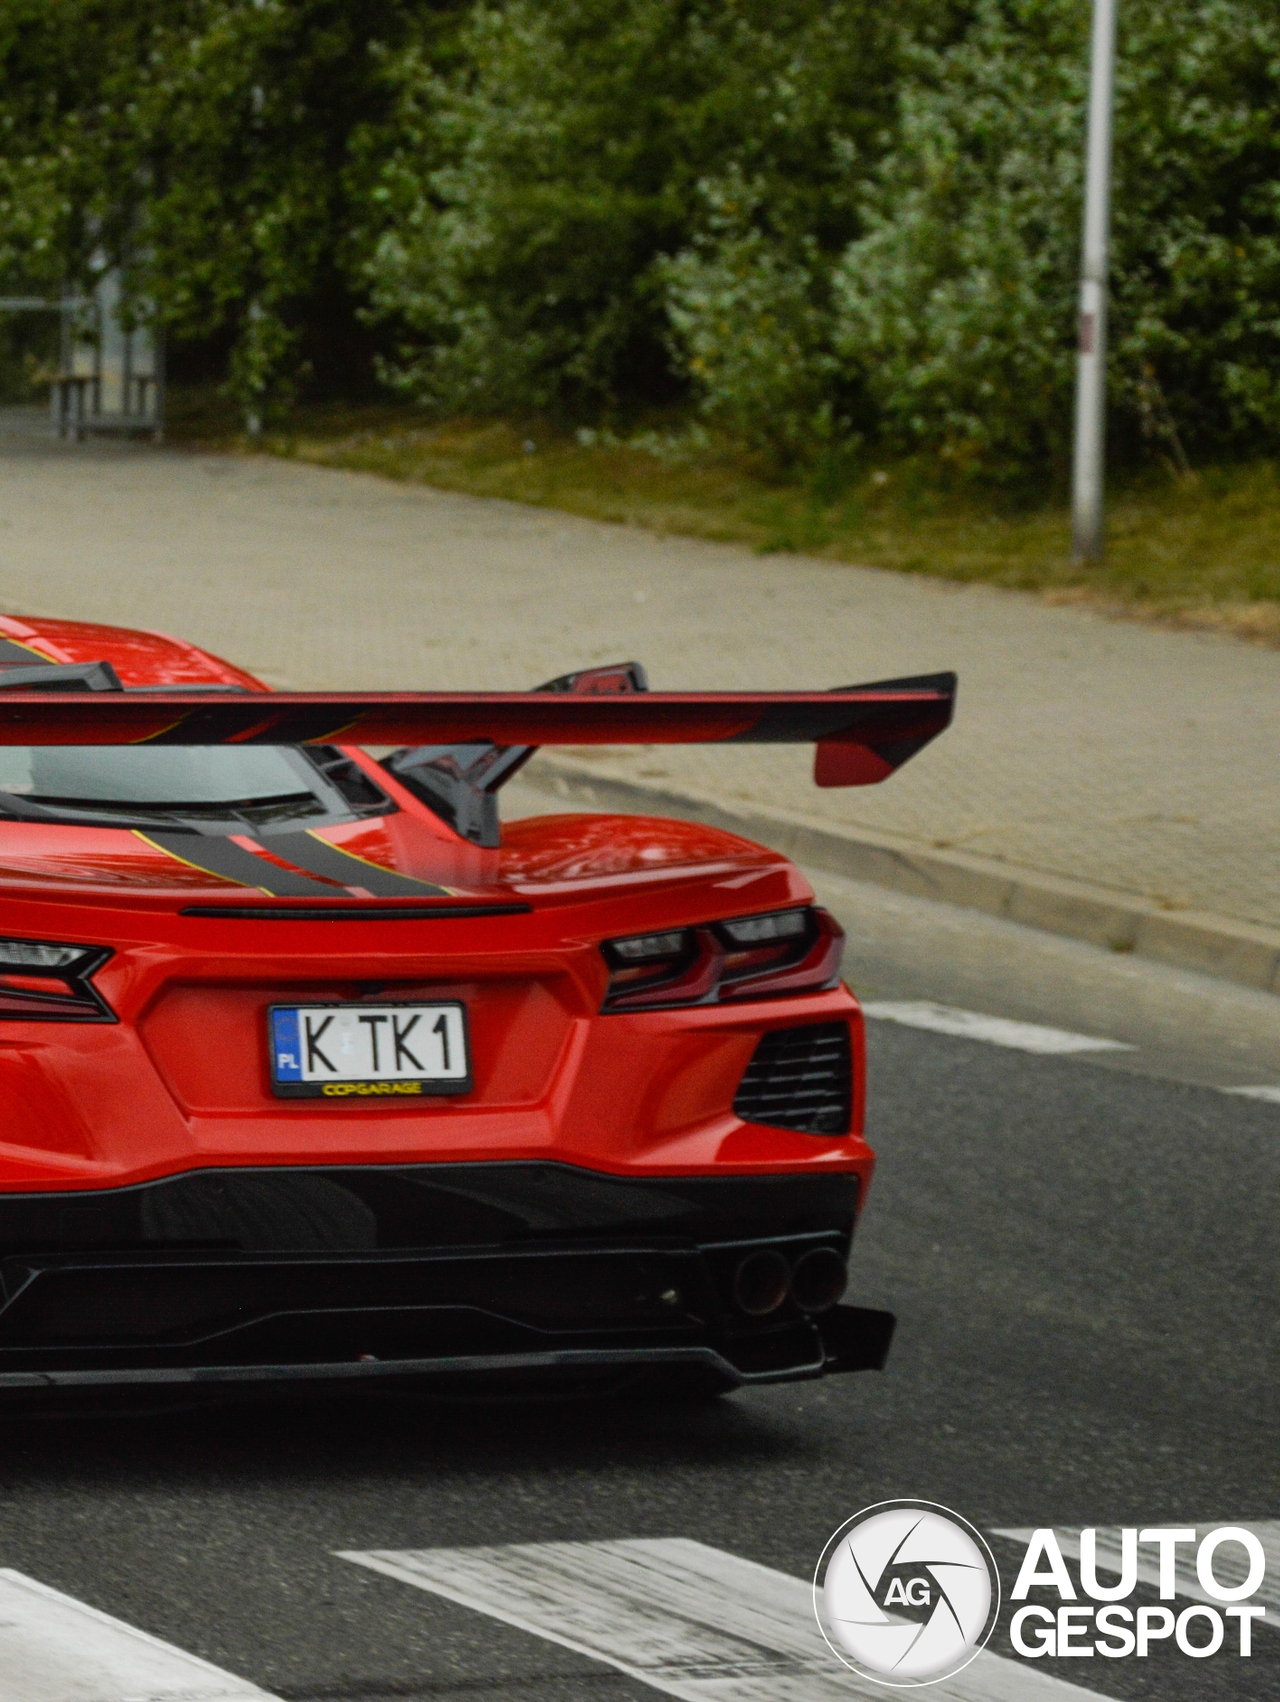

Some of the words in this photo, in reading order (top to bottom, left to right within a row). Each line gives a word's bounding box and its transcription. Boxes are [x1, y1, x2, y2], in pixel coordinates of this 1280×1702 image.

[277, 1053, 299, 1069] PL
[305, 1015, 338, 1072] K
[358, 1014, 451, 1072] TK1
